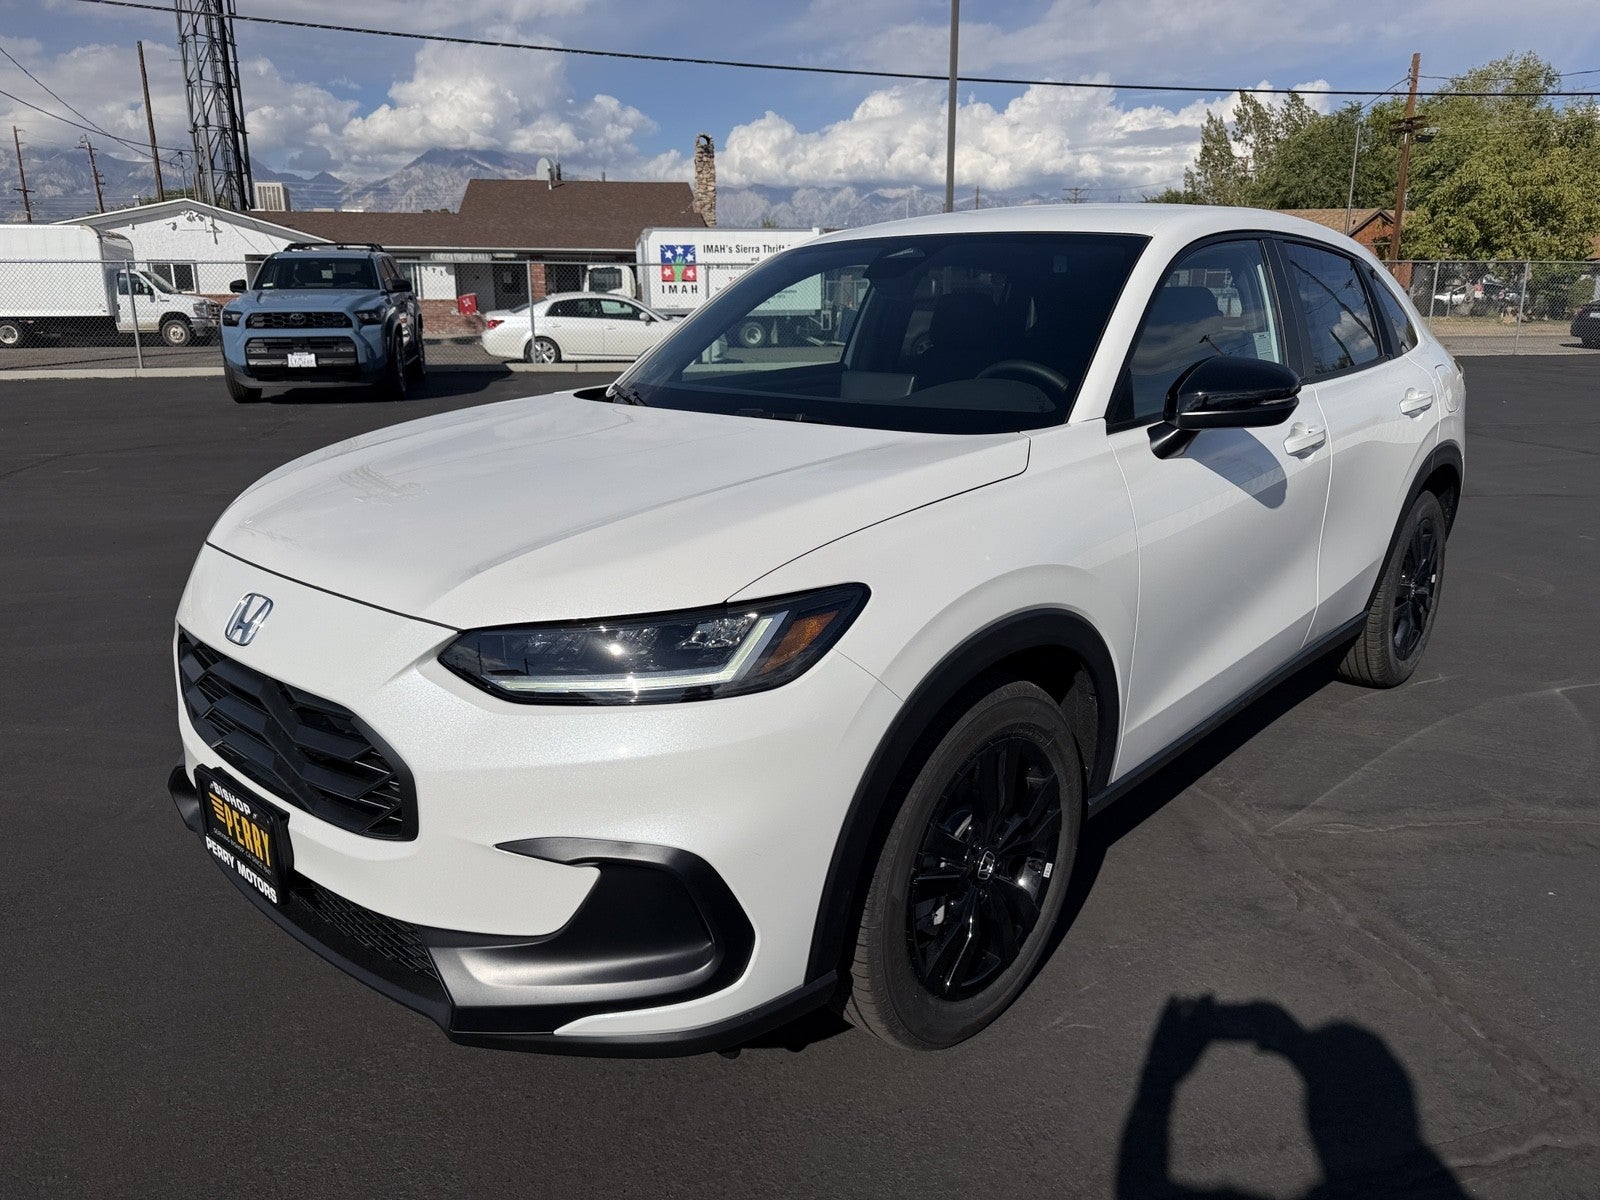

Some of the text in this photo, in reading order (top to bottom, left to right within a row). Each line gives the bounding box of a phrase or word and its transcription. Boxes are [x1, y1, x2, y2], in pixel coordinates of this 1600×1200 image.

[703, 244, 733, 254] IMAH's
[735, 244, 760, 254] Sierra
[661, 285, 698, 294] IMAH
[212, 780, 251, 816] BISHOP
[223, 802, 271, 867] PERRY
[205, 835, 278, 904] PERRY MOTORS
